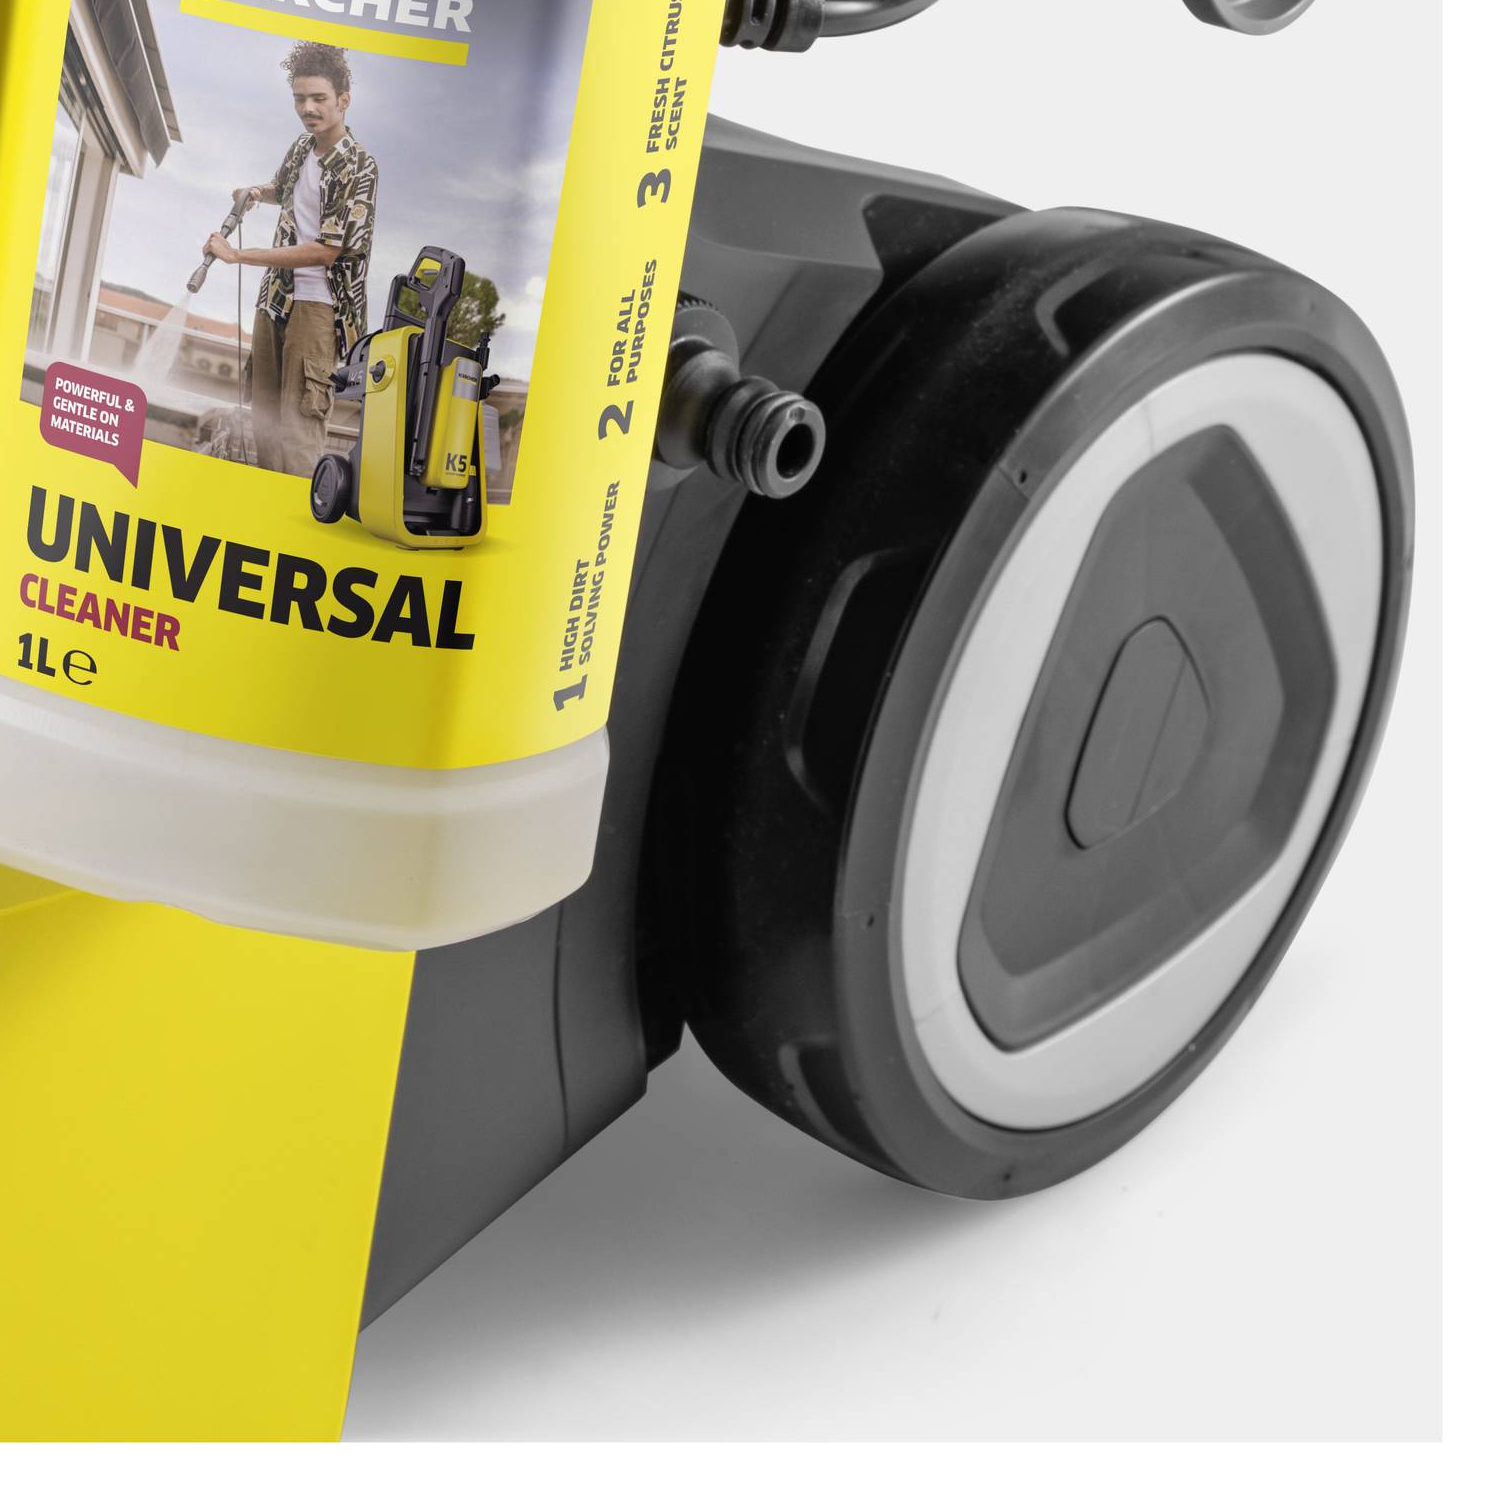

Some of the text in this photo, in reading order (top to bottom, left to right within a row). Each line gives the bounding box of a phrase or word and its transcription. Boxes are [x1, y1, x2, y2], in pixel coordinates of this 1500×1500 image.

[646, 77, 671, 154] FRESH
[665, 76, 688, 151] SCENT
[637, 168, 672, 209] 3
[607, 288, 637, 388] FOR ALL
[625, 258, 658, 384] PURPOSES
[50, 414, 120, 447] MATERIALS
[53, 396, 120, 428] GENTLE ON
[55, 377, 135, 413] POWERFUL &
[597, 400, 635, 441] 2
[445, 453, 468, 473] K5
[26, 485, 476, 650] UNIVERSAL
[578, 479, 621, 666] SOLVING POWER
[19, 573, 181, 652] CLEANER
[559, 558, 590, 672] HIGH DIRT
[553, 674, 588, 712] 1
